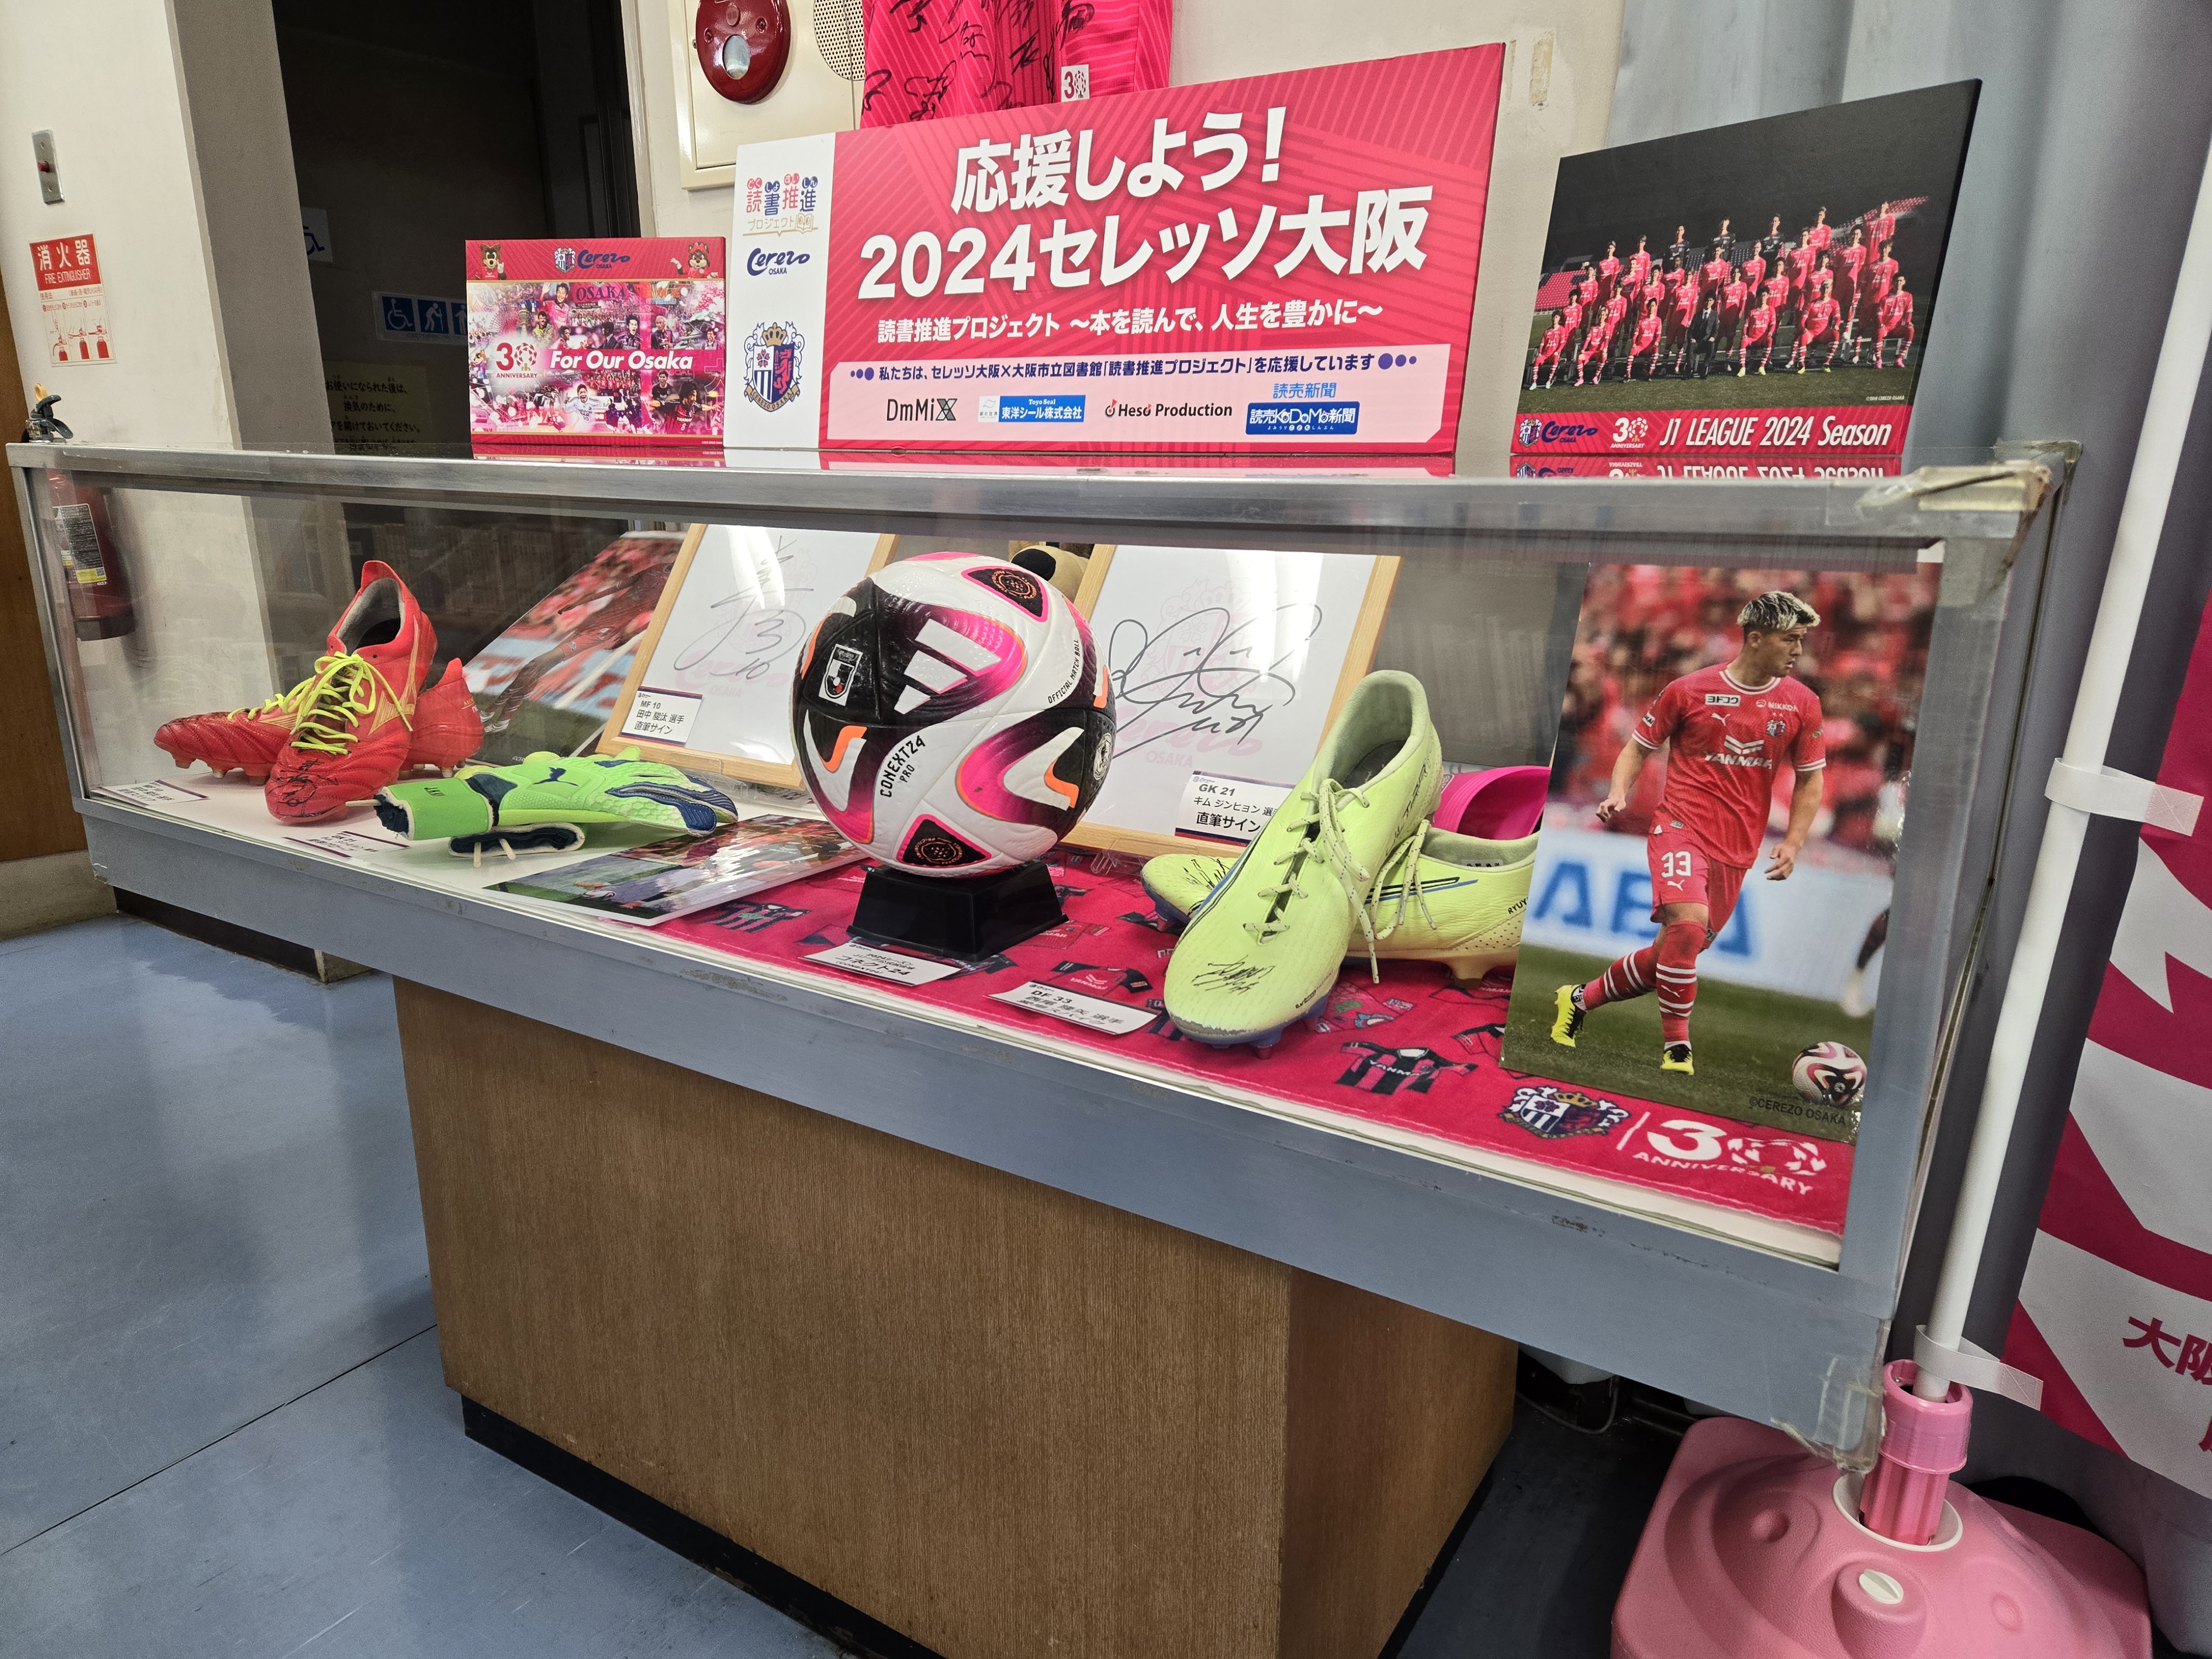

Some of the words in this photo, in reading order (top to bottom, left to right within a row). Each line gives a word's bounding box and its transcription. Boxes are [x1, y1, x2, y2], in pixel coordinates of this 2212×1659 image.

[951, 106, 1287, 215] 応援しよう！
[746, 186, 817, 216] 読書推進
[858, 184, 1433, 300] 2024セレッソ大阪
[37, 239, 91, 270] 消火器
[577, 249, 630, 269] Cerezo
[747, 247, 811, 276] Cerezo
[45, 273, 56, 284] FIRE
[58, 268, 91, 283] EXTINGUISHER
[576, 285, 625, 301] OSAKA
[878, 313, 1060, 343] 読書推進プロジェクト
[1070, 299, 1384, 336] ～本を読んで、人生を豊かに～
[550, 351, 582, 369] For
[586, 351, 624, 370] Our
[628, 350, 693, 370] Osaka
[753, 392, 770, 409] CEREZO
[772, 392, 791, 409] OSAKA
[1273, 383, 1337, 399] 読売新聞
[1001, 406, 1082, 419] 東洋シール株式会社
[1155, 403, 1233, 418] Production
[1541, 421, 1598, 443] Cerezo
[1660, 418, 1681, 446] J1
[1686, 417, 1759, 446] LEAGUE
[1759, 416, 1812, 446] 2024
[1818, 415, 1891, 446] Season
[1048, 680, 1073, 703] OFFICIAL
[1070, 657, 1079, 681] MATCH
[636, 709, 652, 719] 田中
[668, 713, 685, 724] 選手
[634, 721, 673, 734] 直筆サイン
[880, 735, 926, 797] CONEXT24
[1145, 750, 1193, 768] OSAKA
[899, 764, 915, 783] PRO
[1198, 784, 1218, 794] GK
[1219, 787, 1235, 796] 21
[1193, 796, 1211, 807] キム
[1196, 811, 1261, 832] 直筆サイン
[1661, 851, 1692, 878] 33
[1507, 896, 1528, 915] RYUY
[834, 955, 911, 975] コネクト24
[1031, 990, 1053, 998] DF
[1806, 1108, 1846, 1126] OSAKA
[1632, 1151, 1813, 1195] ANNIVERSARY
